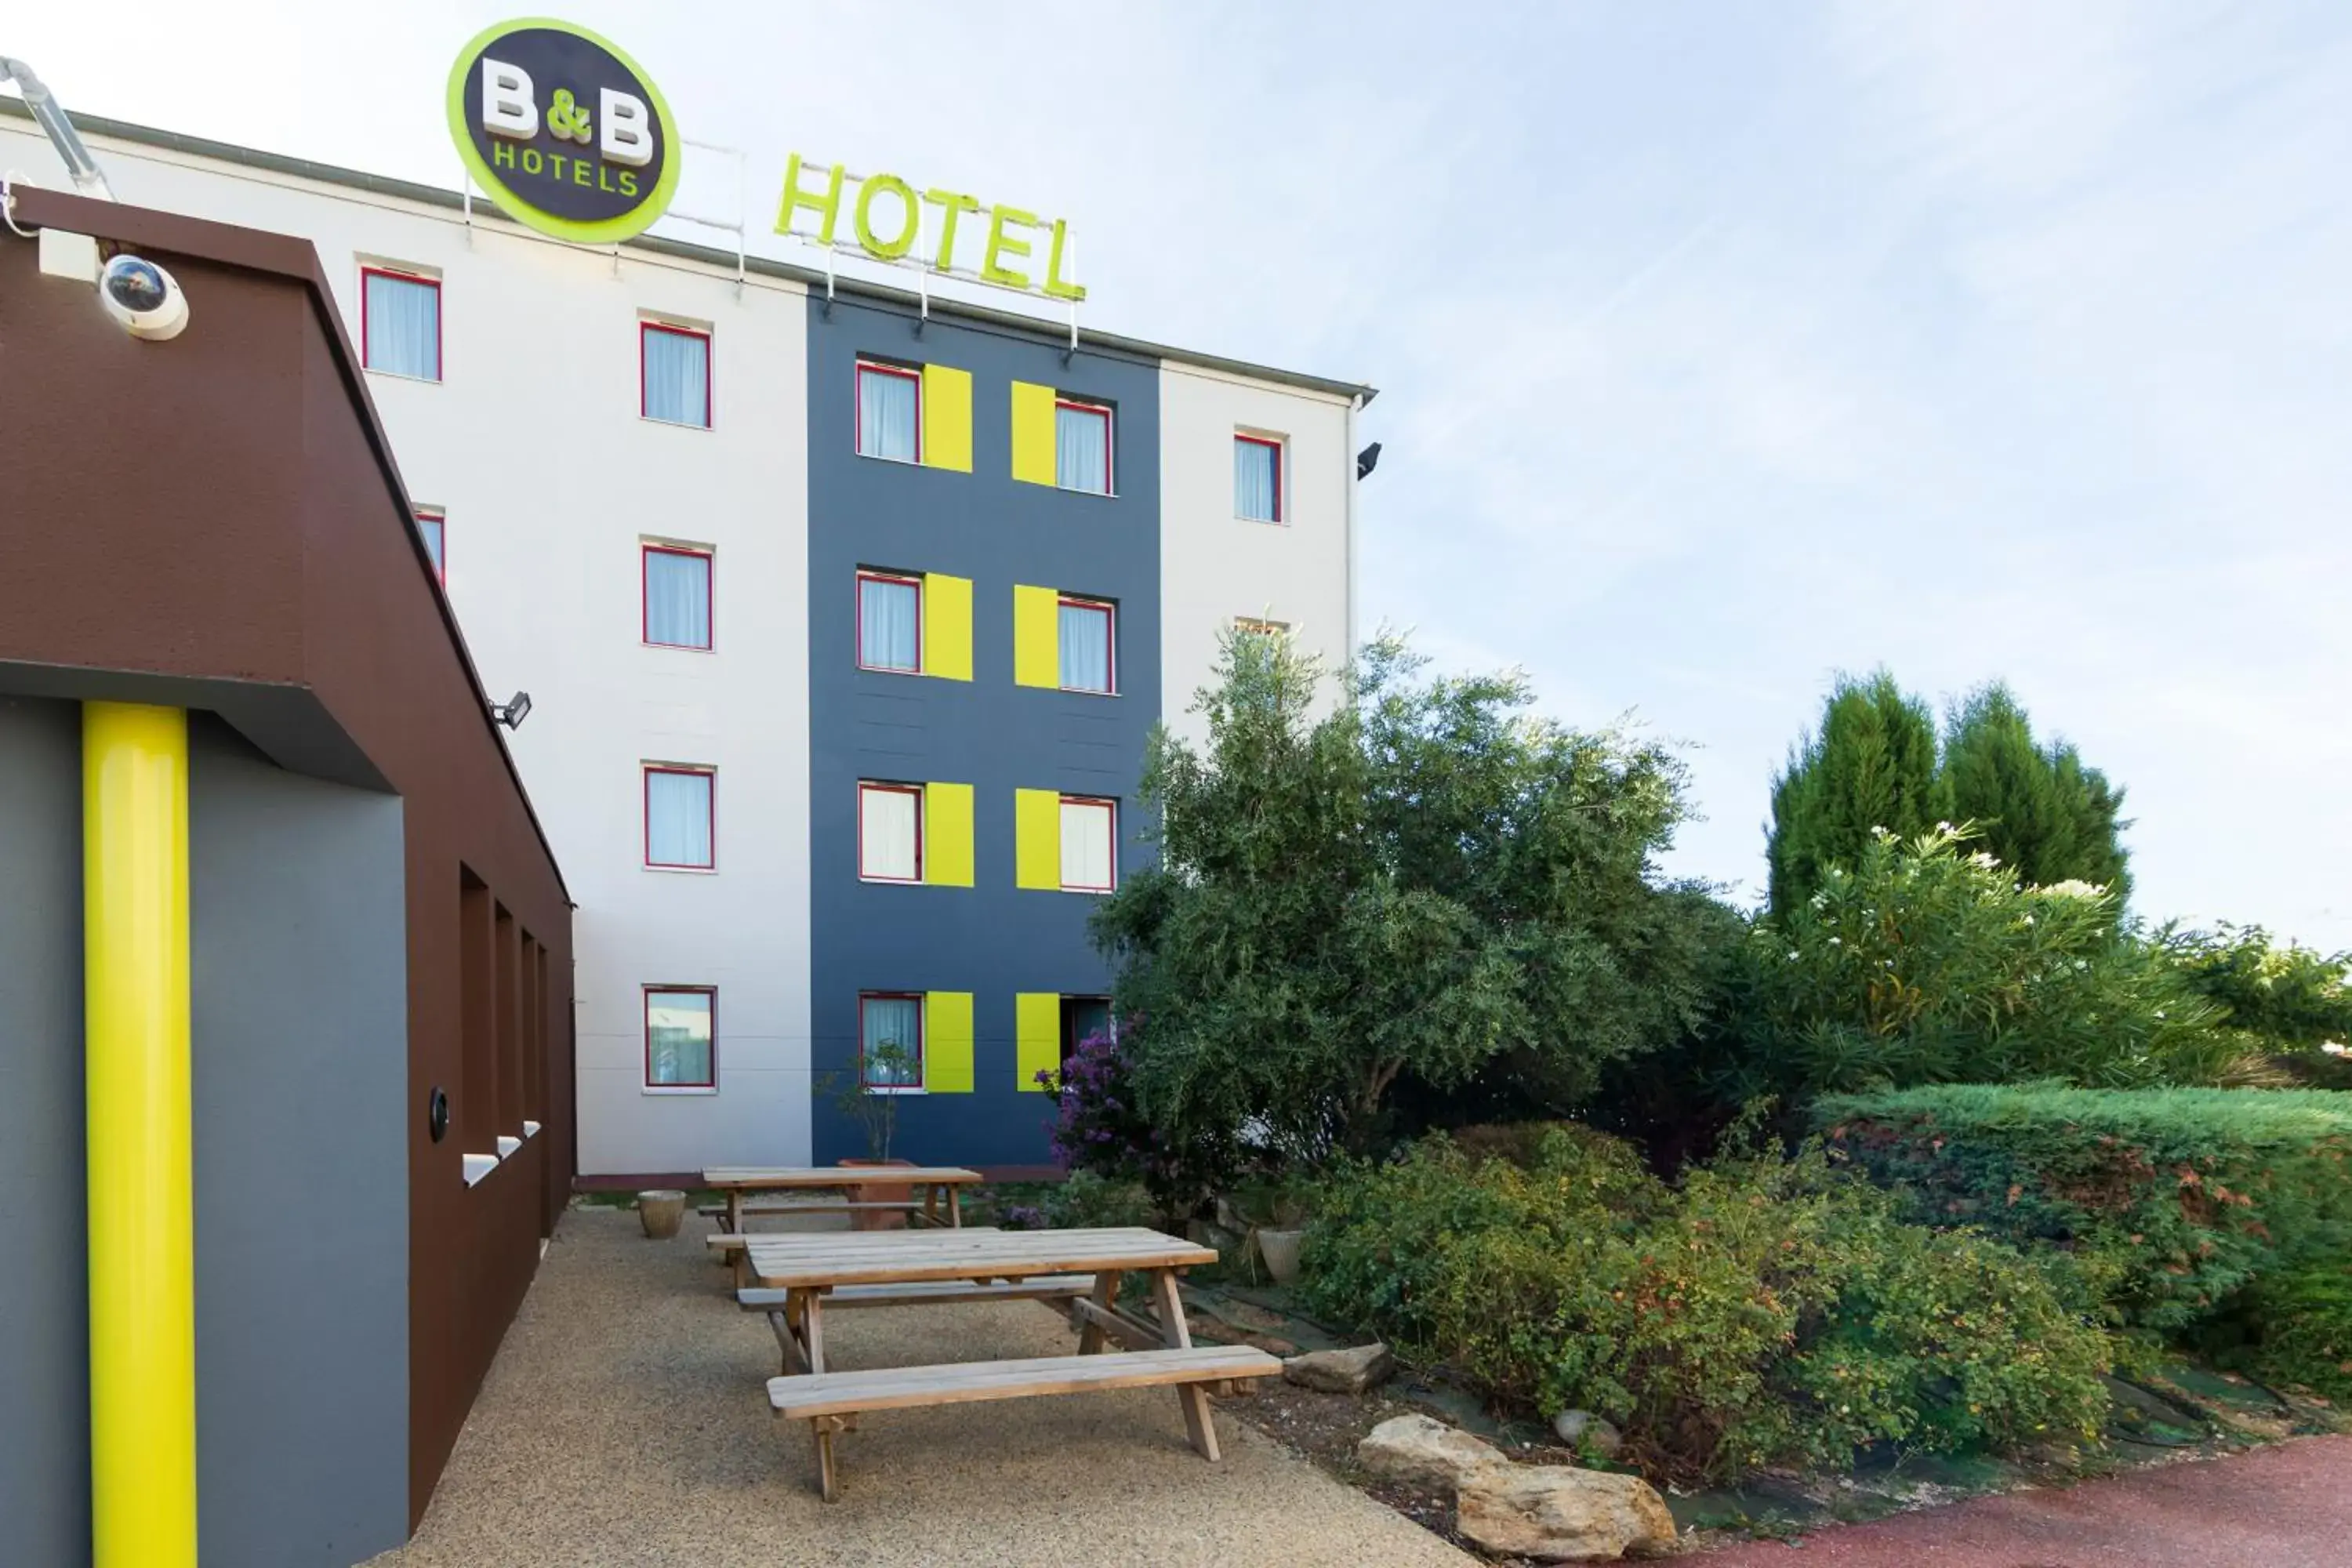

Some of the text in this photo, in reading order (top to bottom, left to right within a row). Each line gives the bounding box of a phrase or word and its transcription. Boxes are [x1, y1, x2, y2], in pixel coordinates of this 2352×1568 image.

[482, 57, 653, 166] B&B
[493, 141, 639, 198] HOTELS
[774, 152, 1087, 301] HOTEL
